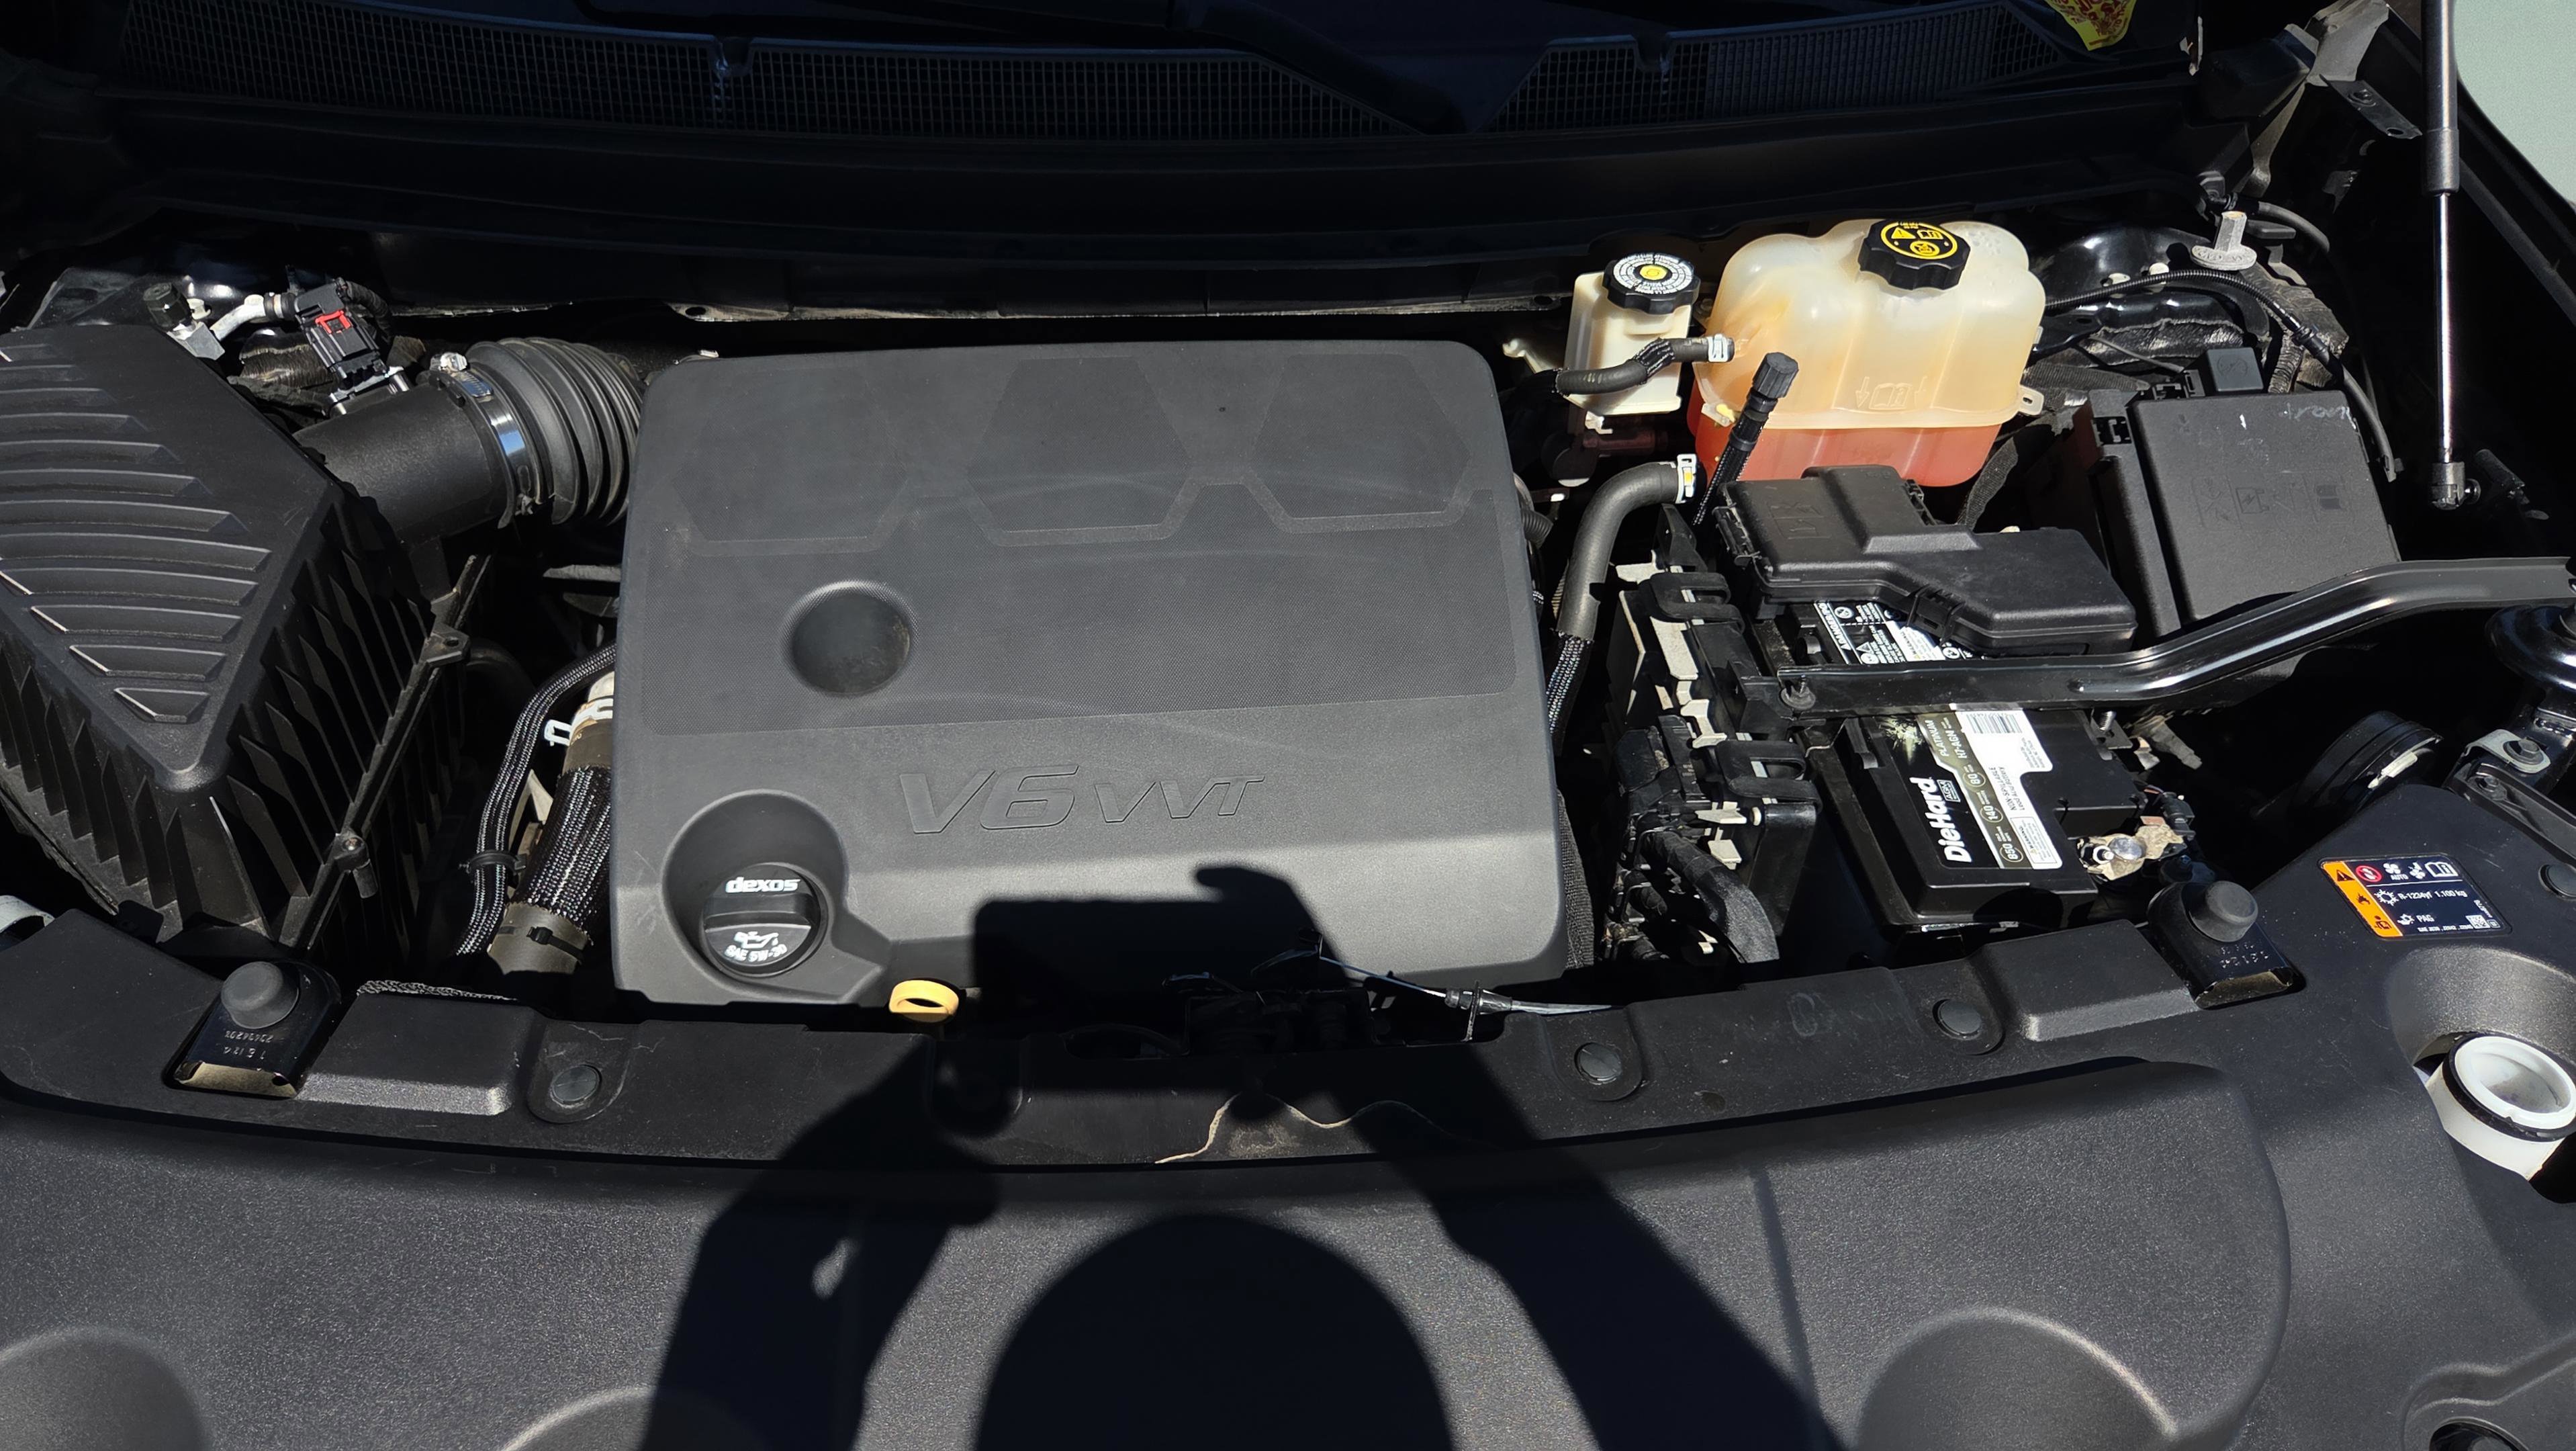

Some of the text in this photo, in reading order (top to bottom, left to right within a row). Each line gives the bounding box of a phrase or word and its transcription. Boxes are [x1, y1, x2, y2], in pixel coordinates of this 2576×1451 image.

[1925, 719, 1949, 757] PLATINUM
[1968, 773, 1981, 785] 80
[900, 765, 1266, 834] V6 VVT
[1909, 777, 1972, 863] DieHard
[1983, 805, 1998, 820] 140
[2003, 843, 2019, 860] 850
[725, 877, 801, 893] dexos
[2397, 891, 2434, 900] R-1234yf
[2456, 890, 2467, 898] kg
[2416, 915, 2435, 923] PAG
[724, 944, 788, 962] SAE 5W-30
